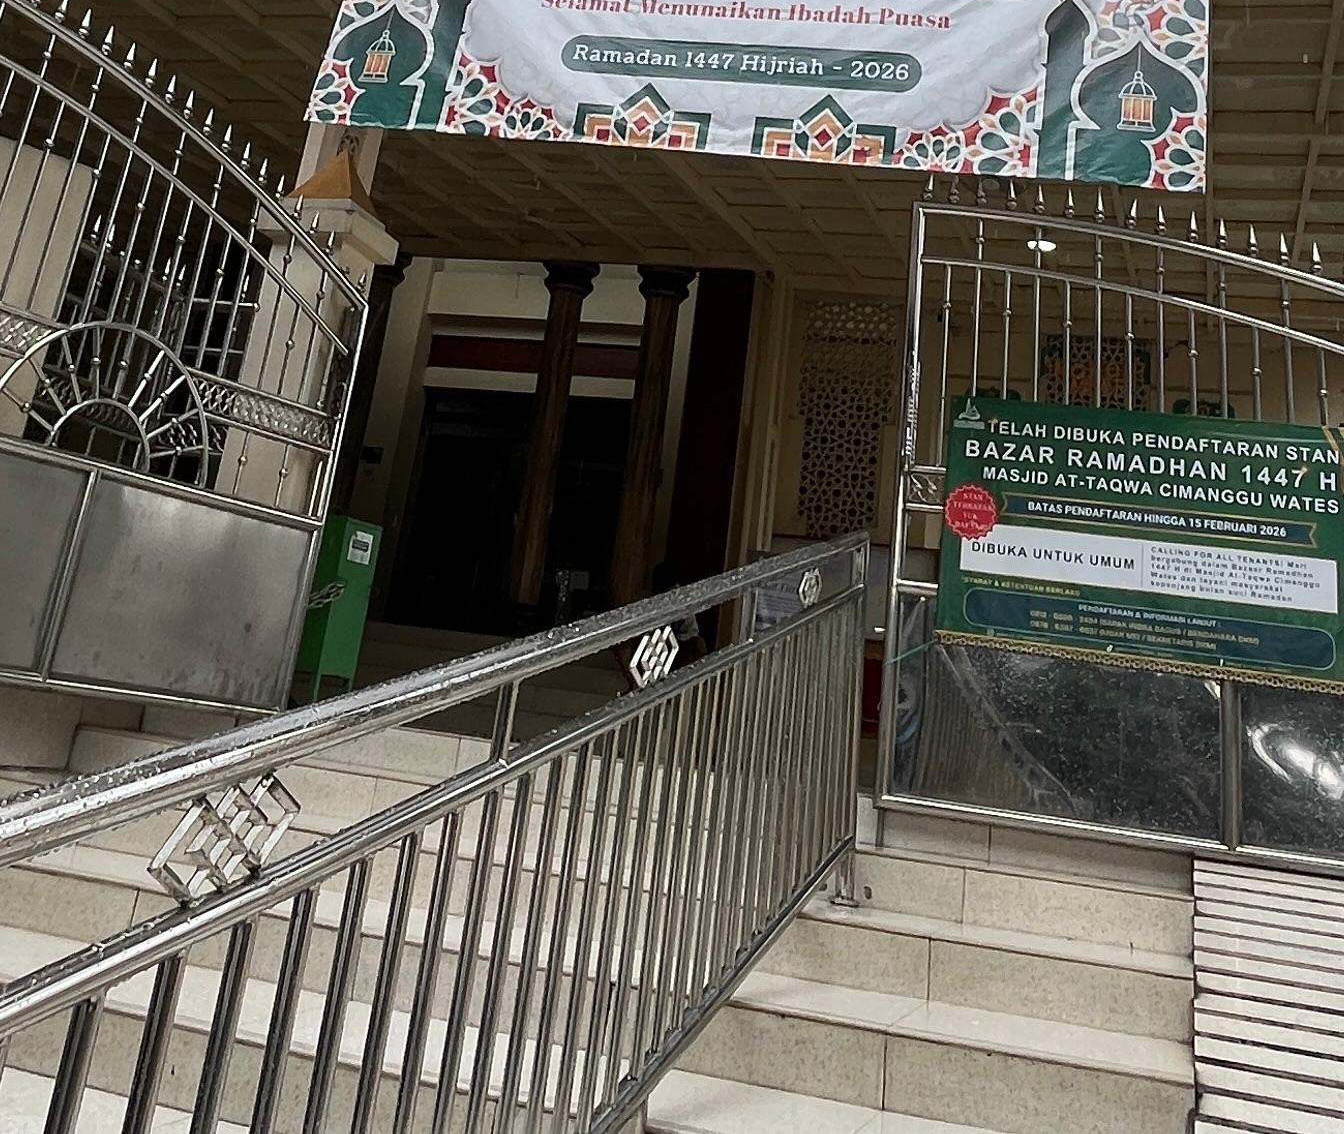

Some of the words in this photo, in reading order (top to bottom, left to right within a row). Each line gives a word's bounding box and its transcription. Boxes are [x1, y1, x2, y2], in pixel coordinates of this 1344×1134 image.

[789, 4, 870, 25] Ibadah
[879, 7, 950, 29] Puasa
[573, 44, 677, 67] Ramadan
[685, 51, 734, 69] 1447
[741, 54, 824, 76] Hijriah
[851, 60, 909, 80] 2026
[987, 419, 1046, 438] TELAH
[1054, 425, 1125, 445] DIBUKA
[1132, 432, 1278, 459] PENDAFTARAN
[1286, 446, 1339, 464] STAN
[965, 439, 1054, 464] BAZAR
[1067, 448, 1227, 481] RAMADHAN
[1241, 464, 1308, 488] 1447
[1319, 471, 1336, 492] H
[983, 466, 1049, 485] MASJID
[1055, 474, 1153, 495] AT-TAQWA
[1159, 483, 1262, 506] CIMANGGU
[1269, 494, 1339, 514] WATES
[1028, 501, 1063, 514] BATAS
[1065, 504, 1142, 522] PENDAFTARAN
[1144, 515, 1186, 528] HINGGA
[1189, 518, 1202, 528] 15
[1204, 520, 1256, 534] FEBRUARI
[1260, 525, 1287, 537] 2026
[971, 541, 1027, 559] DIBUKA
[1033, 548, 1084, 565] UNTUK
[1089, 554, 1135, 570] UMUM
[1150, 546, 1191, 557] CALLING
[1194, 550, 1213, 560] FOR
[1216, 553, 1234, 562] ALL
